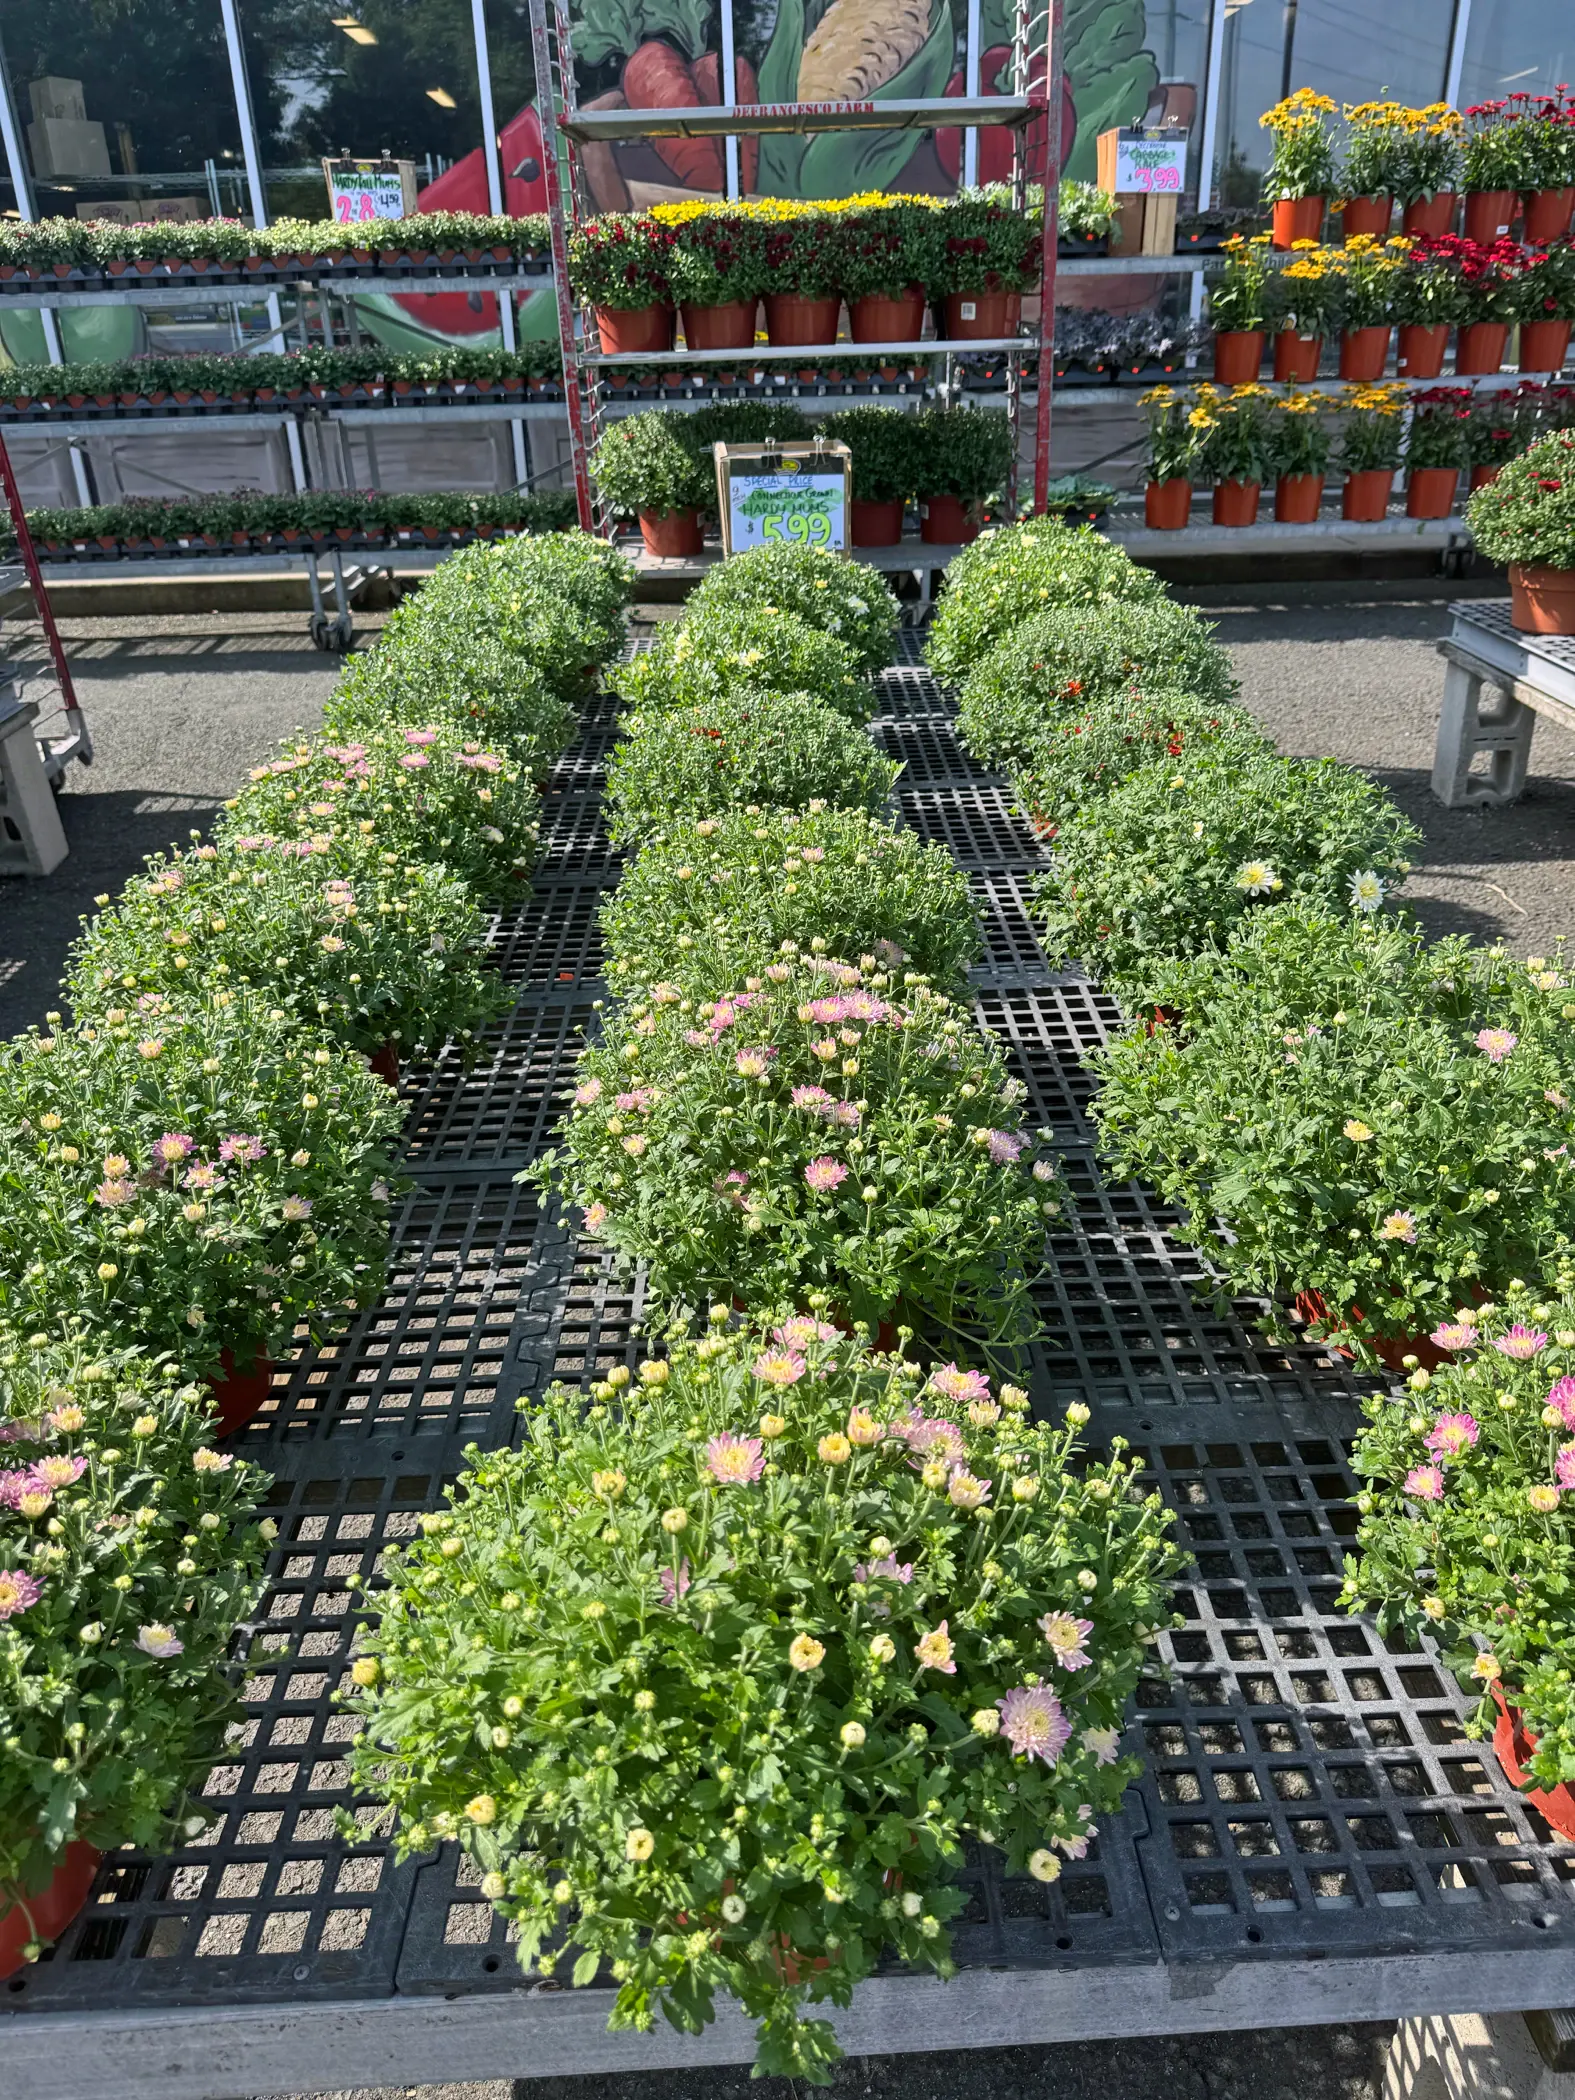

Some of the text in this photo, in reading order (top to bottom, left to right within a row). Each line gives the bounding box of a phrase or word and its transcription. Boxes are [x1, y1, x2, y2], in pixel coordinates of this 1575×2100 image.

[732, 102, 874, 118] DEFRANCESCO FARM
[337, 195, 354, 223] 2
[744, 476, 814, 487] SPECIAL PRICE
[743, 501, 829, 517] HARDY MUMS
